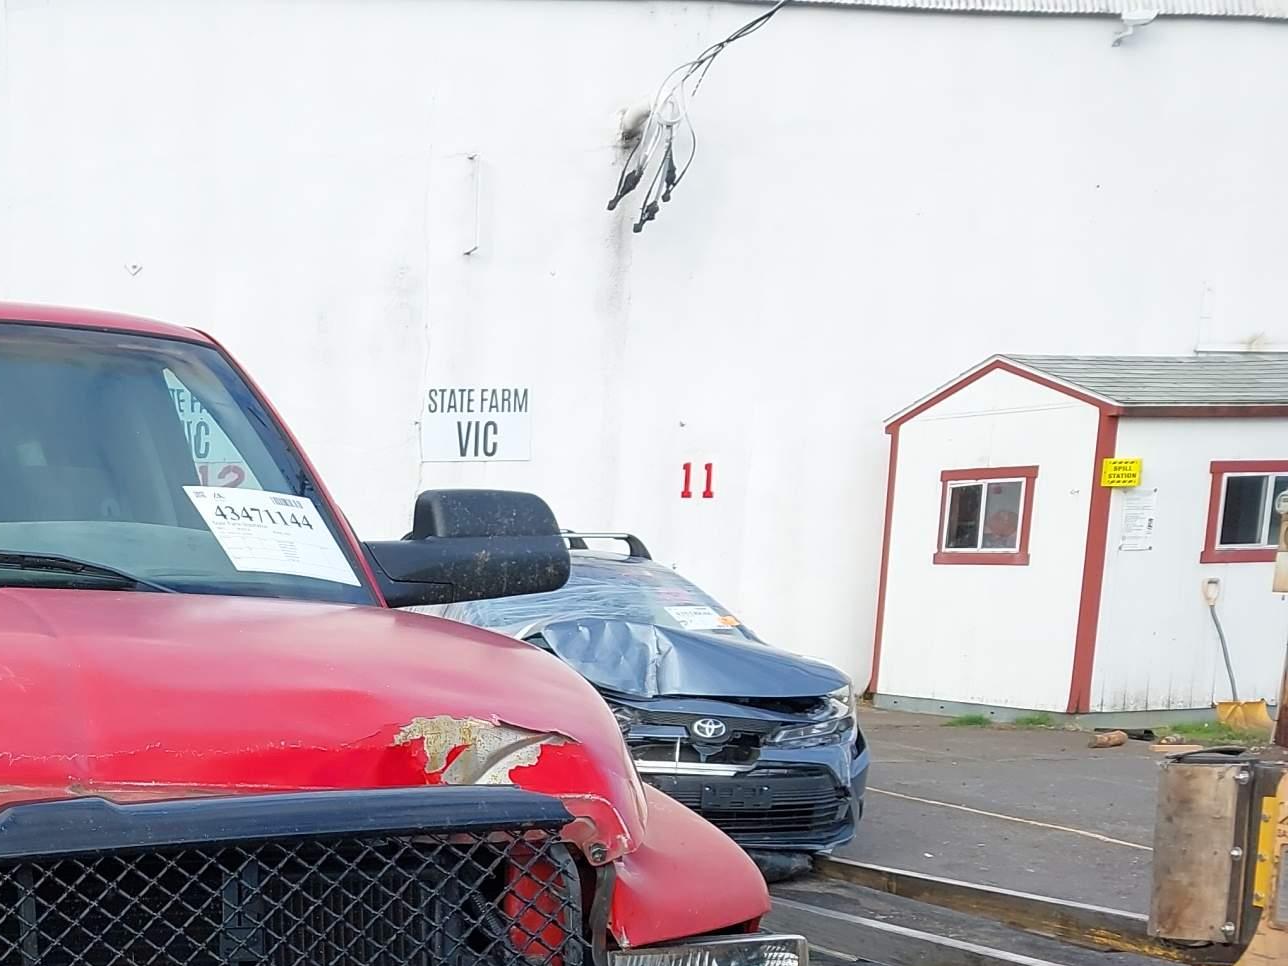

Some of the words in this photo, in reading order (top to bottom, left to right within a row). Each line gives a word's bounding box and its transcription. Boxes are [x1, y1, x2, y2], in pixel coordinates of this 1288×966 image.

[428, 388, 475, 413] STATE
[480, 388, 528, 413] FARM
[457, 420, 498, 457] VIC
[681, 462, 714, 498] 11
[215, 505, 314, 530] 43471144
